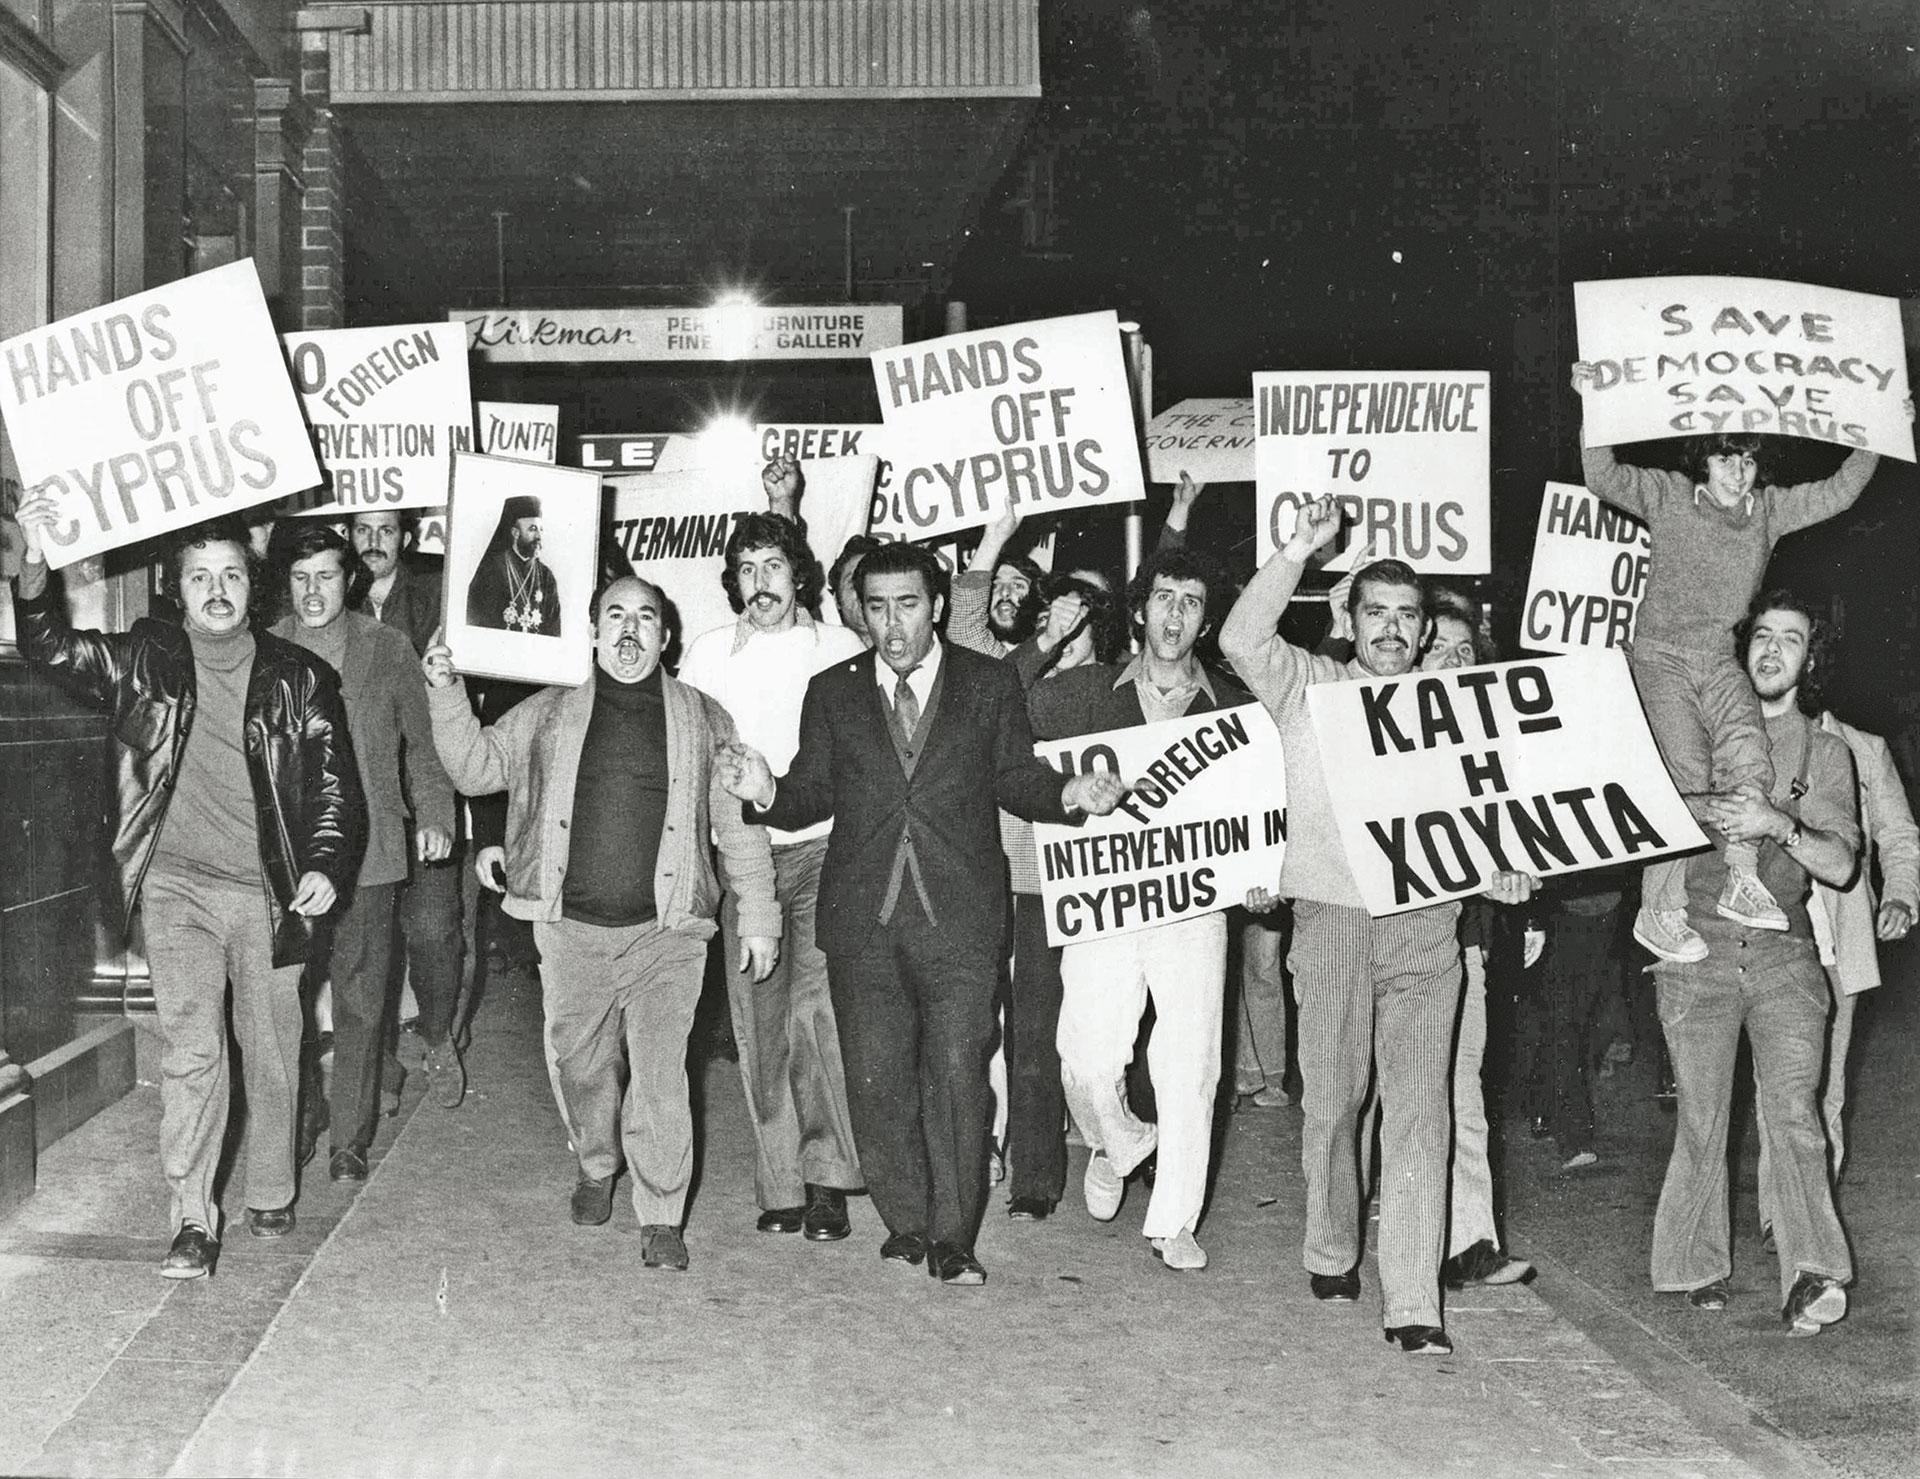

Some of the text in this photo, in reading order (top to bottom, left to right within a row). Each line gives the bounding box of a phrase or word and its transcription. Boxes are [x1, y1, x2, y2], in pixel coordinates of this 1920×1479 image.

[667, 335, 713, 350] FINE
[776, 333, 865, 349] GALLERY
[763, 315, 864, 332] URNITURE
[1660, 303, 1835, 343] SAVE
[5, 303, 177, 405] HANDS
[322, 329, 440, 420] FOREIGN
[885, 337, 1043, 408] HANDS
[1592, 350, 1896, 391] DEMOCRACY
[125, 359, 221, 441] OFF
[990, 387, 1076, 446] OFF
[1165, 414, 1222, 430] THE
[1259, 381, 1486, 437] INDEPENDENCE
[1667, 382, 1833, 418] SAVE
[313, 423, 471, 460] RVENTION IN
[483, 413, 556, 461] JUNTA
[761, 427, 864, 462] GREEK
[1146, 434, 1255, 450] GOVERN
[1668, 409, 1869, 447] CYPRUS
[39, 418, 277, 547] CYPRUS
[903, 438, 1111, 527] CYPRUS
[1327, 448, 1372, 482] TO
[1269, 491, 1469, 562] CPRUS
[1611, 551, 1650, 598] OF
[1527, 589, 1635, 648] CYPR
[1117, 712, 1250, 825] FOREIGN
[1044, 815, 1250, 881] INTERVENTION
[1056, 867, 1217, 937] CYPRUS
